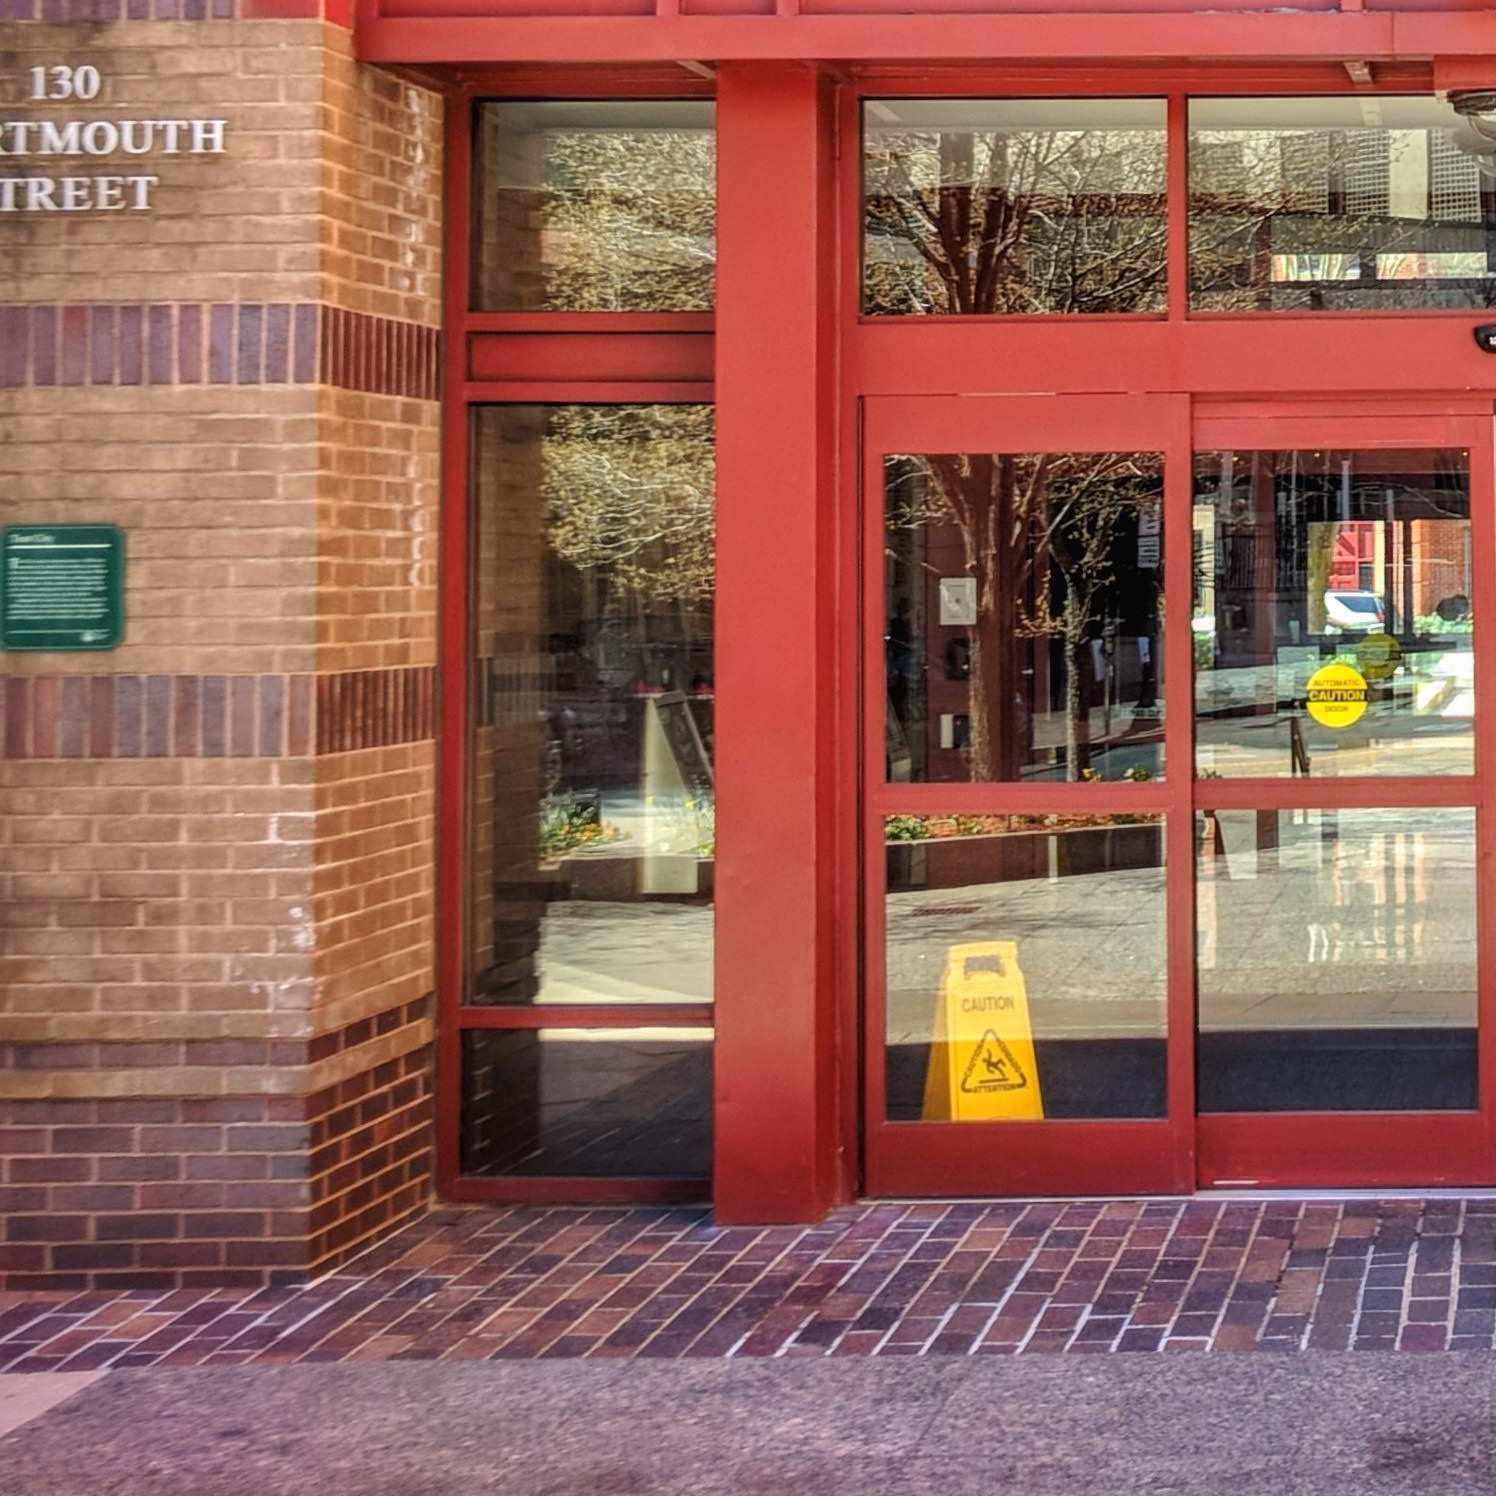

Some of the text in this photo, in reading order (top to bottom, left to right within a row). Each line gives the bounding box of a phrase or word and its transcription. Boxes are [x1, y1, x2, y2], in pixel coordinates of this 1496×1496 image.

[30, 65, 101, 100] 130
[1312, 679, 1361, 687] AUTOMATIC
[1308, 690, 1365, 701] CAUTION
[1324, 705, 1349, 713] DOOR
[962, 996, 1015, 1012] CAUTION
